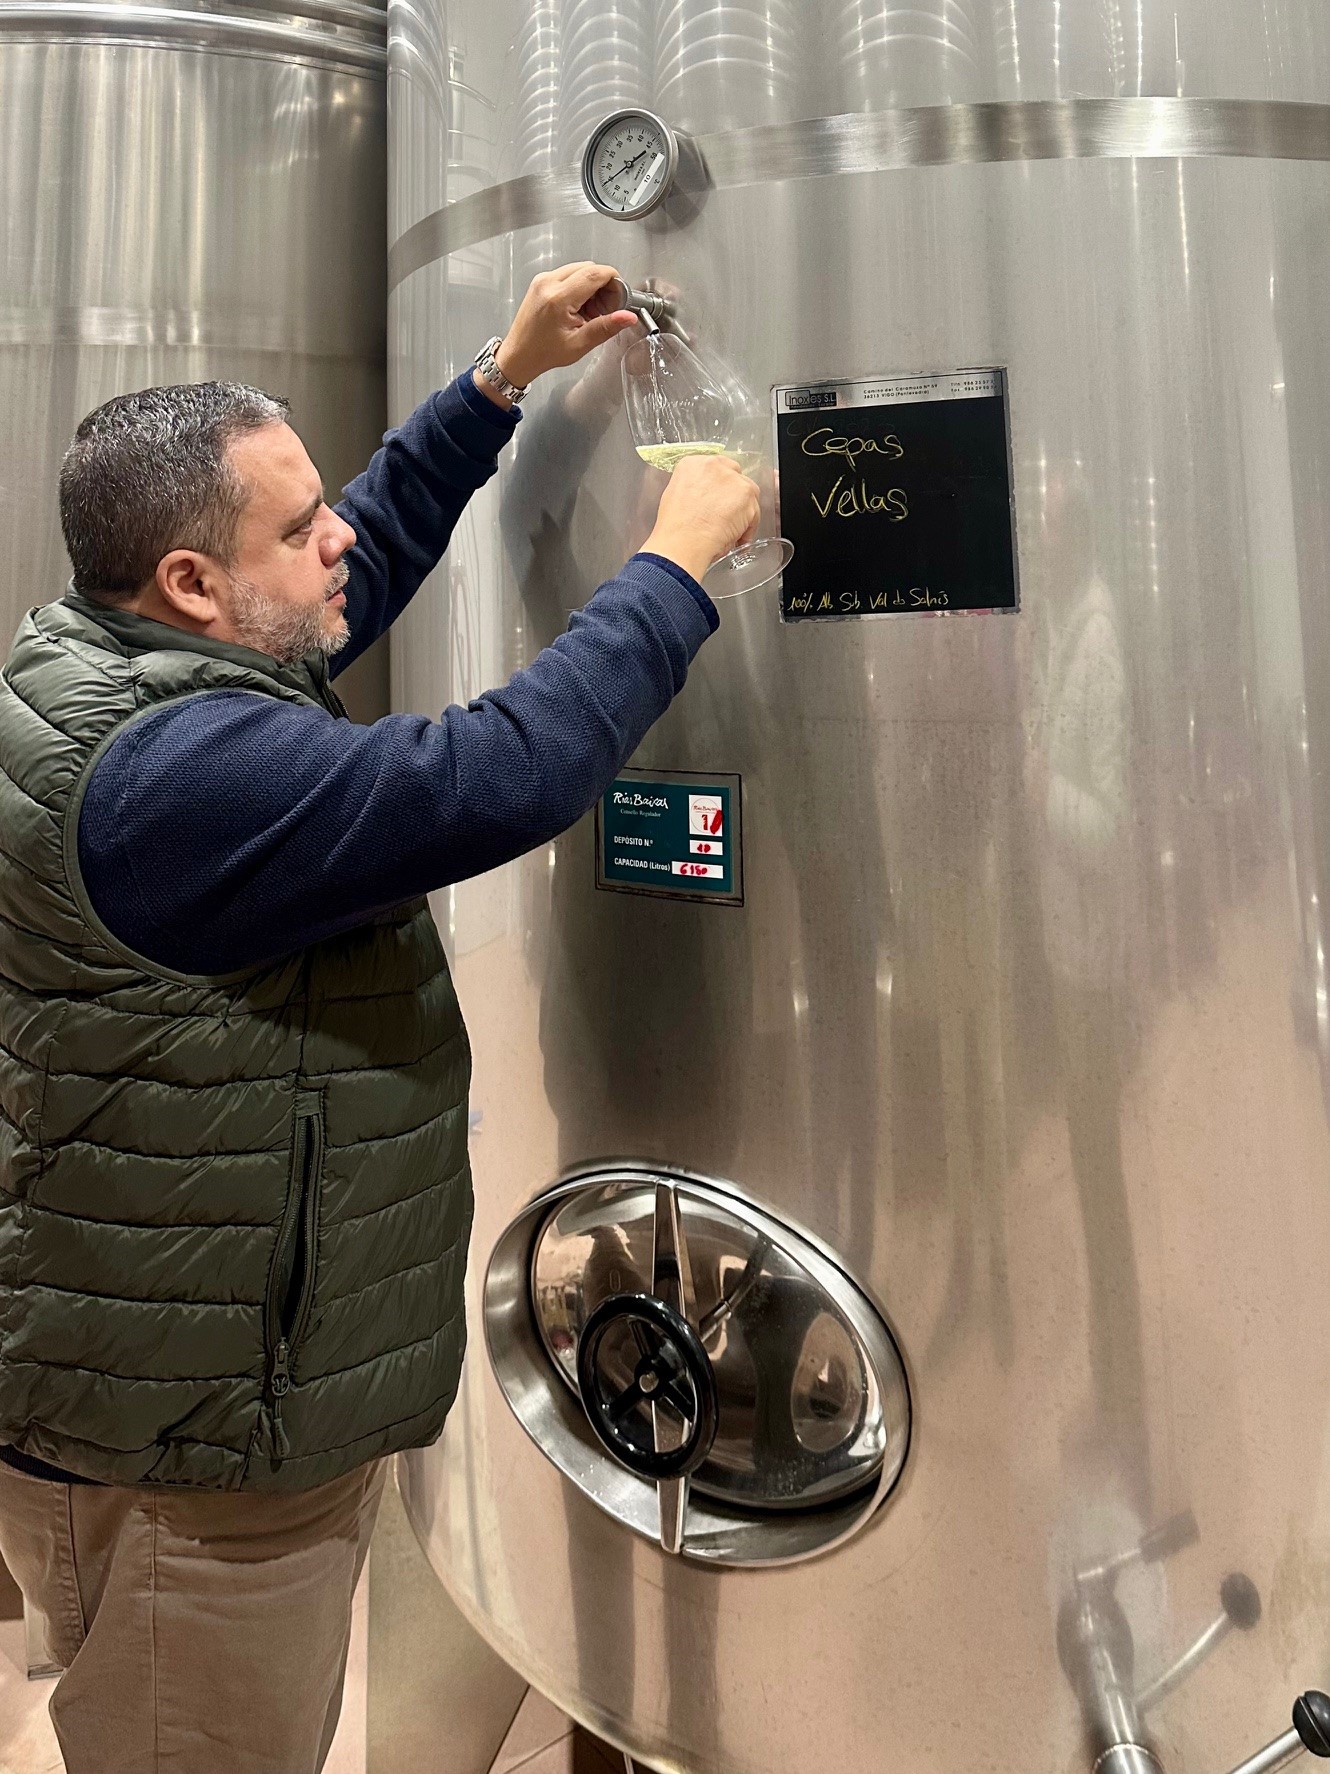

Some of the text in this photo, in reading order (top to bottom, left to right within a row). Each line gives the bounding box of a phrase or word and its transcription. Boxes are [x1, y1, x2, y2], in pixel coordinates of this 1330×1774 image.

[801, 427, 905, 472] Cepas
[811, 474, 909, 523] Vellas
[869, 591, 887, 610] Val
[614, 857, 671, 872] CAPACIDAD (Litros)
